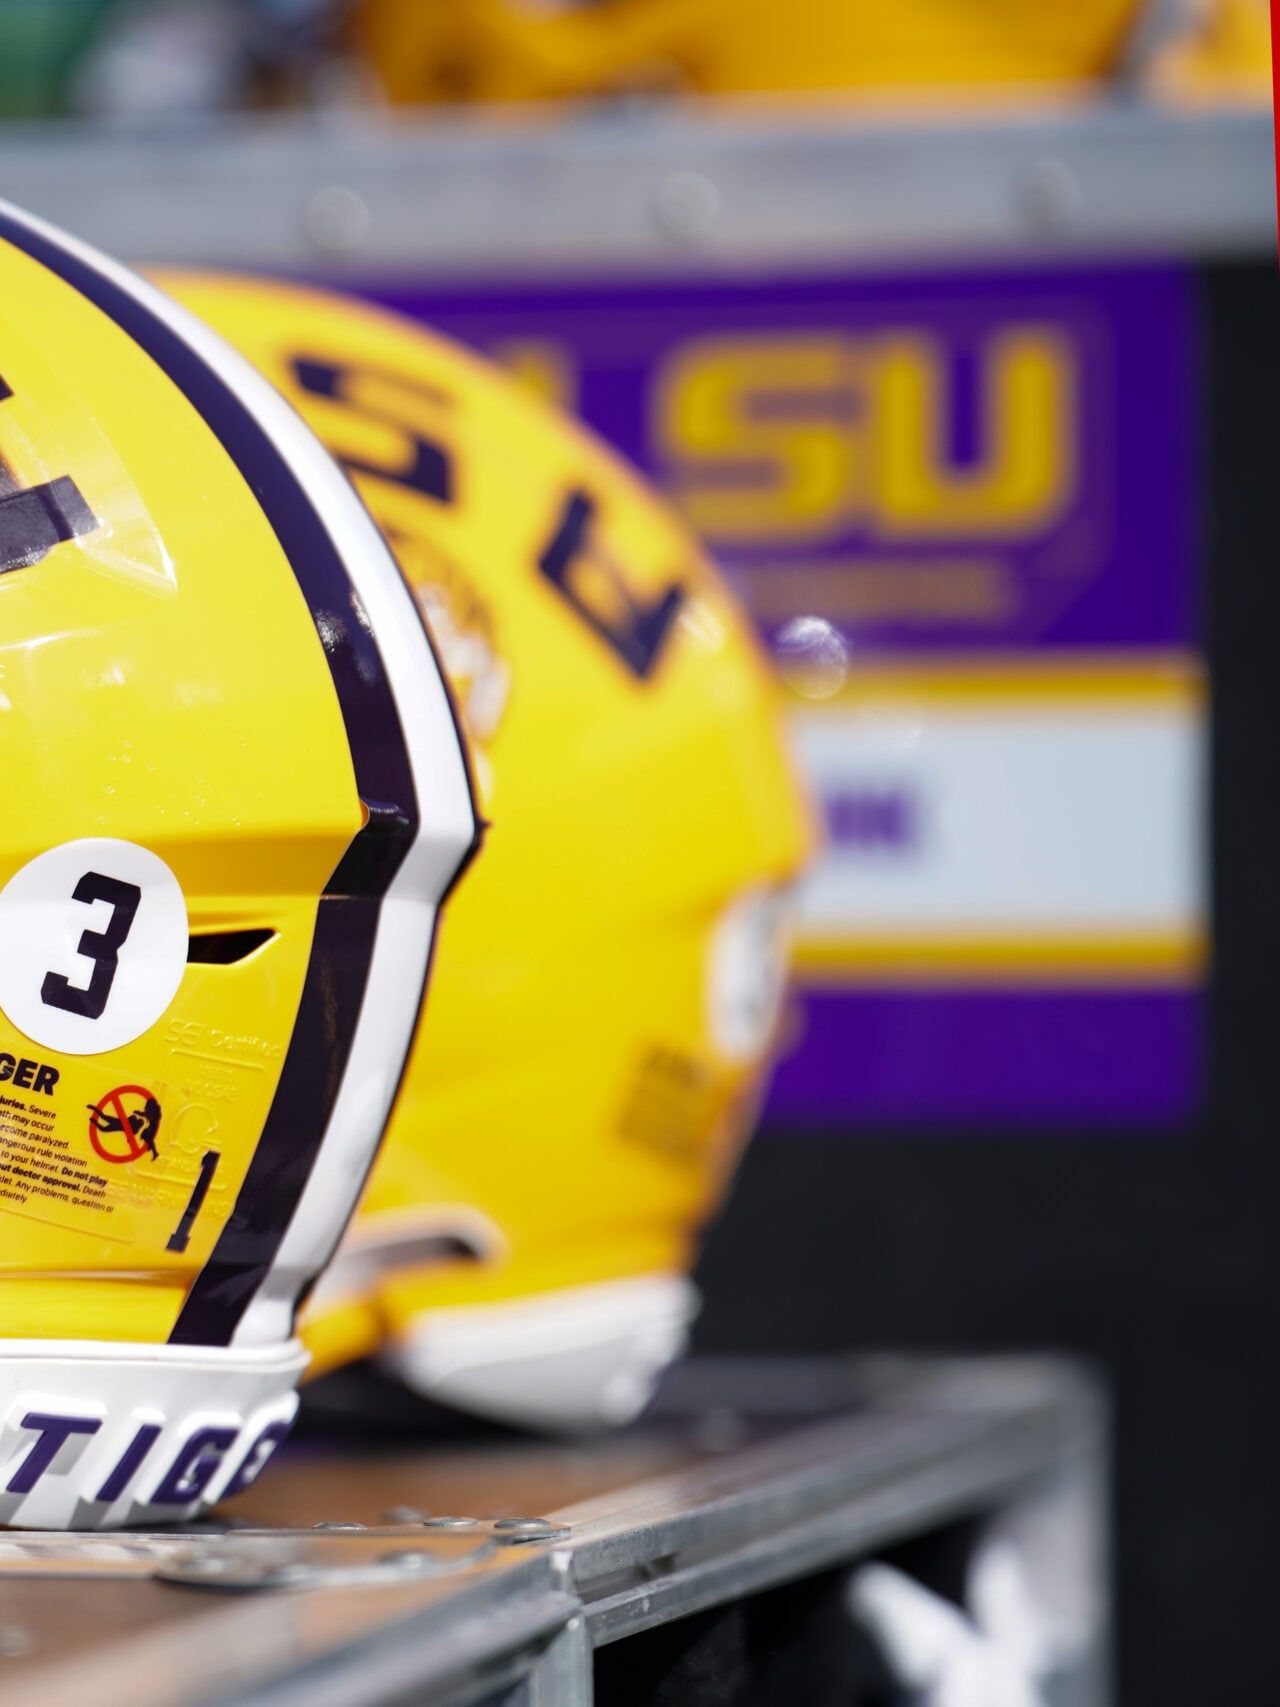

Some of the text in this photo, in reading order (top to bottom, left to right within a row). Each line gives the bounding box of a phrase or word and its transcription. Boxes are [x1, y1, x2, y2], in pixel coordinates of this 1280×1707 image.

[40, 871, 141, 1019] 3
[11, 1114, 31, 1127] may
[28, 1104, 57, 1120] Severe
[36, 1148, 53, 1159] rule
[0, 1150, 10, 1159] to
[9, 1153, 29, 1164] your
[61, 1166, 74, 1177] Do
[73, 1171, 90, 1181] not
[88, 1175, 109, 1189] play
[11, 1166, 42, 1181] doctor
[41, 1175, 81, 1192] approval.
[82, 1185, 106, 1198] Death
[14, 1180, 32, 1192] Any
[71, 1196, 106, 1211] question
[165, 1149, 221, 1252] 1
